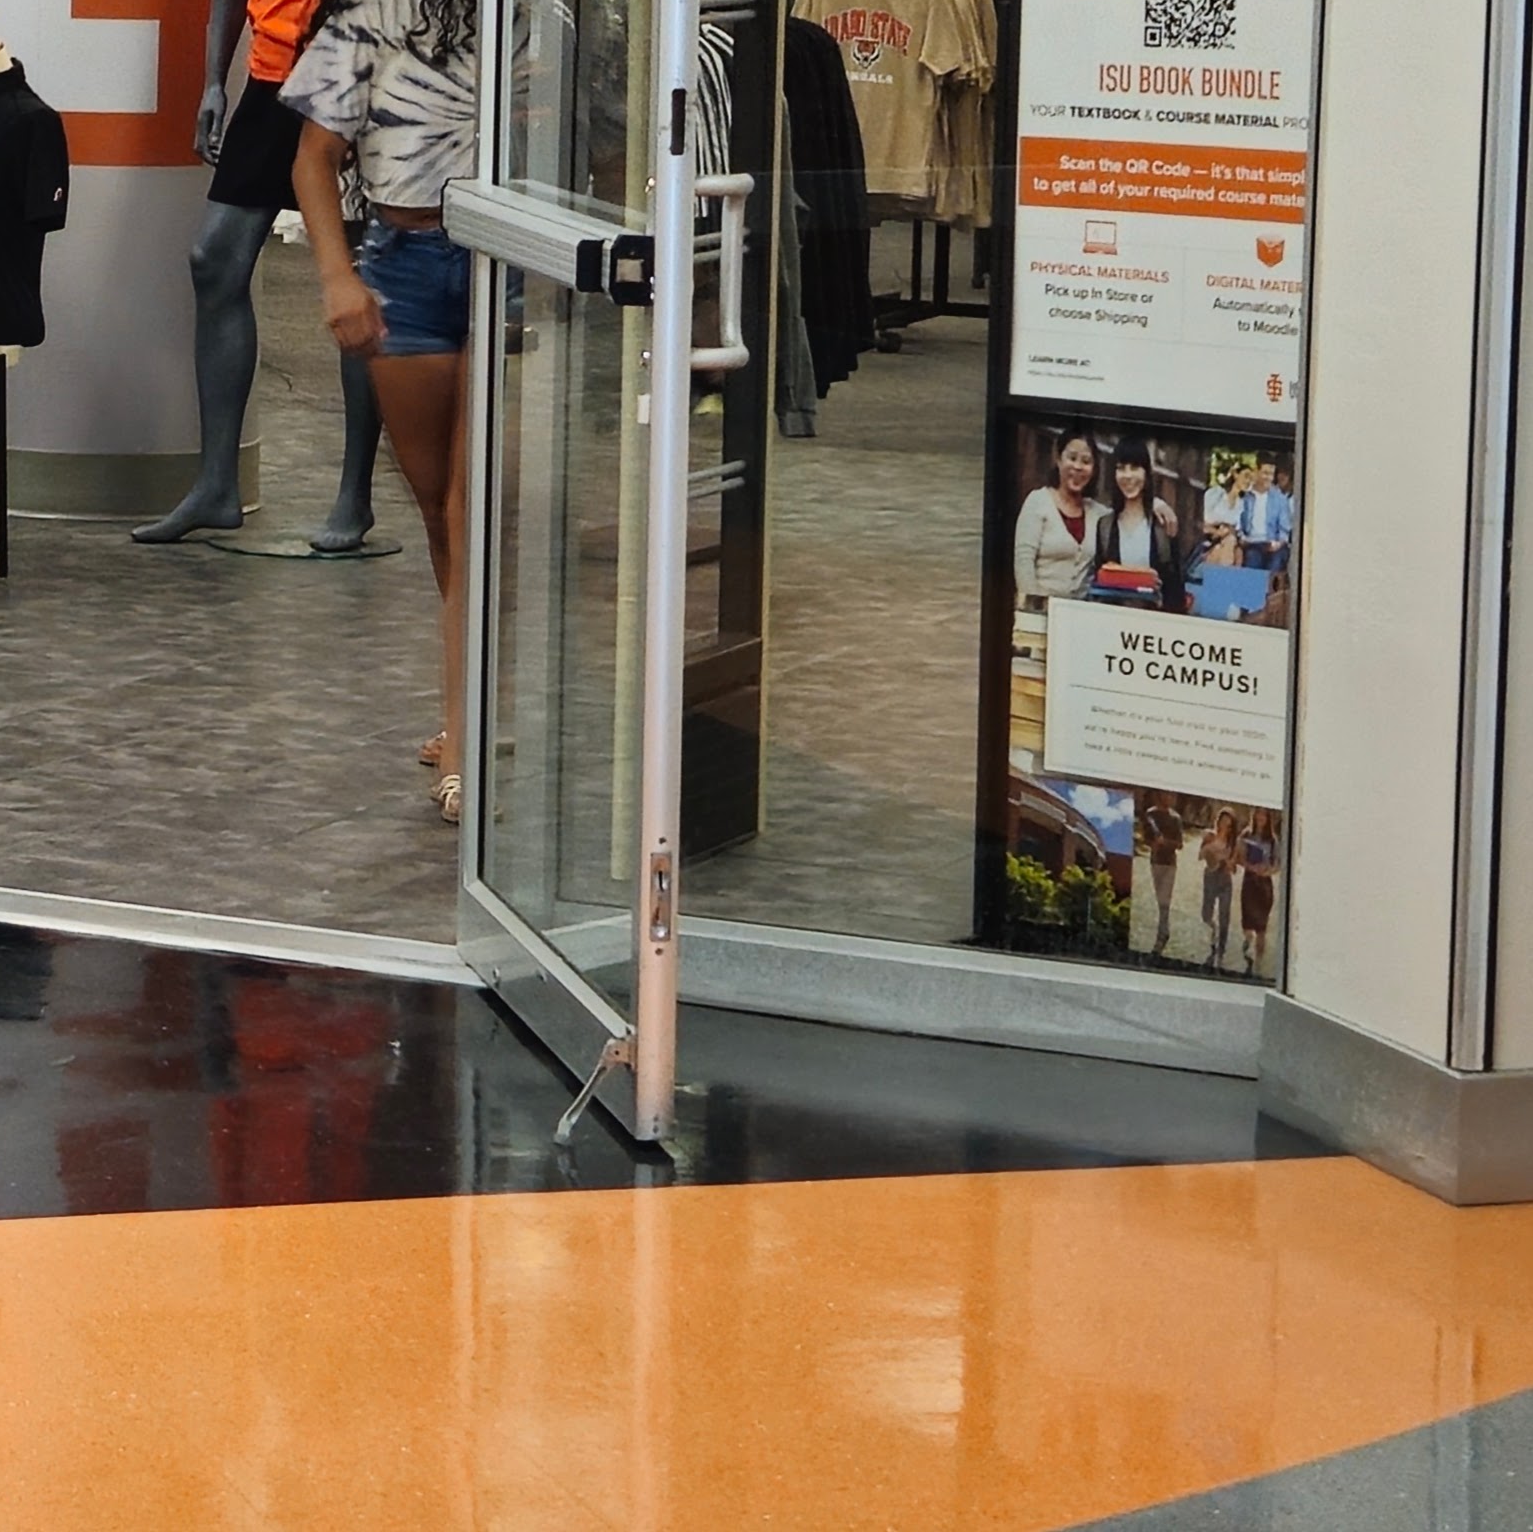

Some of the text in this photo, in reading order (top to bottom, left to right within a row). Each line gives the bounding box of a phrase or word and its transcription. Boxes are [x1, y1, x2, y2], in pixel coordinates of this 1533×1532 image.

[1098, 64, 1283, 101] ISU BOOK BUNDLE
[1029, 103, 1067, 118] YOUR
[1068, 105, 1142, 122] TEXTBOOK
[1156, 110, 1211, 125] COURSE
[1214, 113, 1280, 129] MATERIAL
[1060, 155, 1096, 171] Scan
[1098, 157, 1122, 173] the
[1125, 159, 1149, 174] QR
[1151, 161, 1191, 177] Code
[1235, 166, 1265, 181] that
[1267, 169, 1305, 186] simpl
[1033, 176, 1050, 191] to
[1051, 179, 1077, 196] get
[1079, 179, 1097, 193] all
[1099, 180, 1117, 195] of
[1117, 184, 1151, 199] your
[1153, 184, 1215, 204] required
[1217, 190, 1267, 206] course
[1029, 260, 1171, 284] PHYSICAL MATERIALS
[1206, 274, 1256, 291] DIGITAL
[1044, 283, 1070, 297] Pick
[1072, 288, 1090, 301] up
[1105, 288, 1139, 303] Store
[1140, 293, 1154, 304] or
[1094, 309, 1149, 329] Shipping
[1237, 320, 1251, 332] to
[1119, 630, 1244, 668] WELCOME
[1104, 654, 1260, 696] TO CAMPUS!
